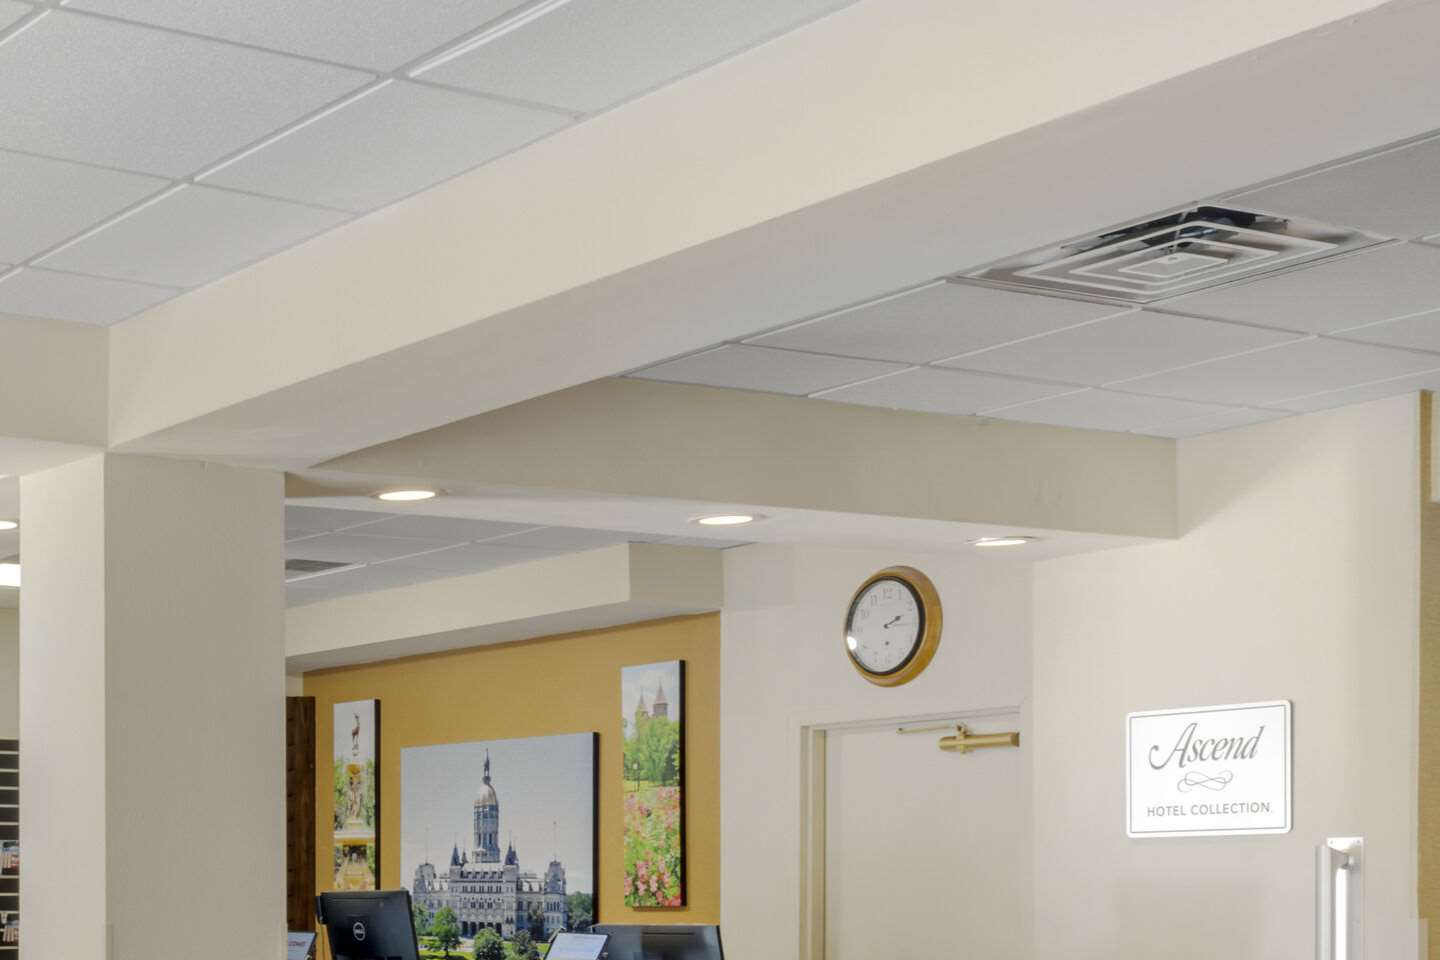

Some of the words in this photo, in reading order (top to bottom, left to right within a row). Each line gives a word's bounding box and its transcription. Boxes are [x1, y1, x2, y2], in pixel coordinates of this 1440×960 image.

[1149, 722, 1265, 770] Ascend
[1147, 805, 1186, 817] HOTEL
[1190, 802, 1270, 816] COLLECTION
